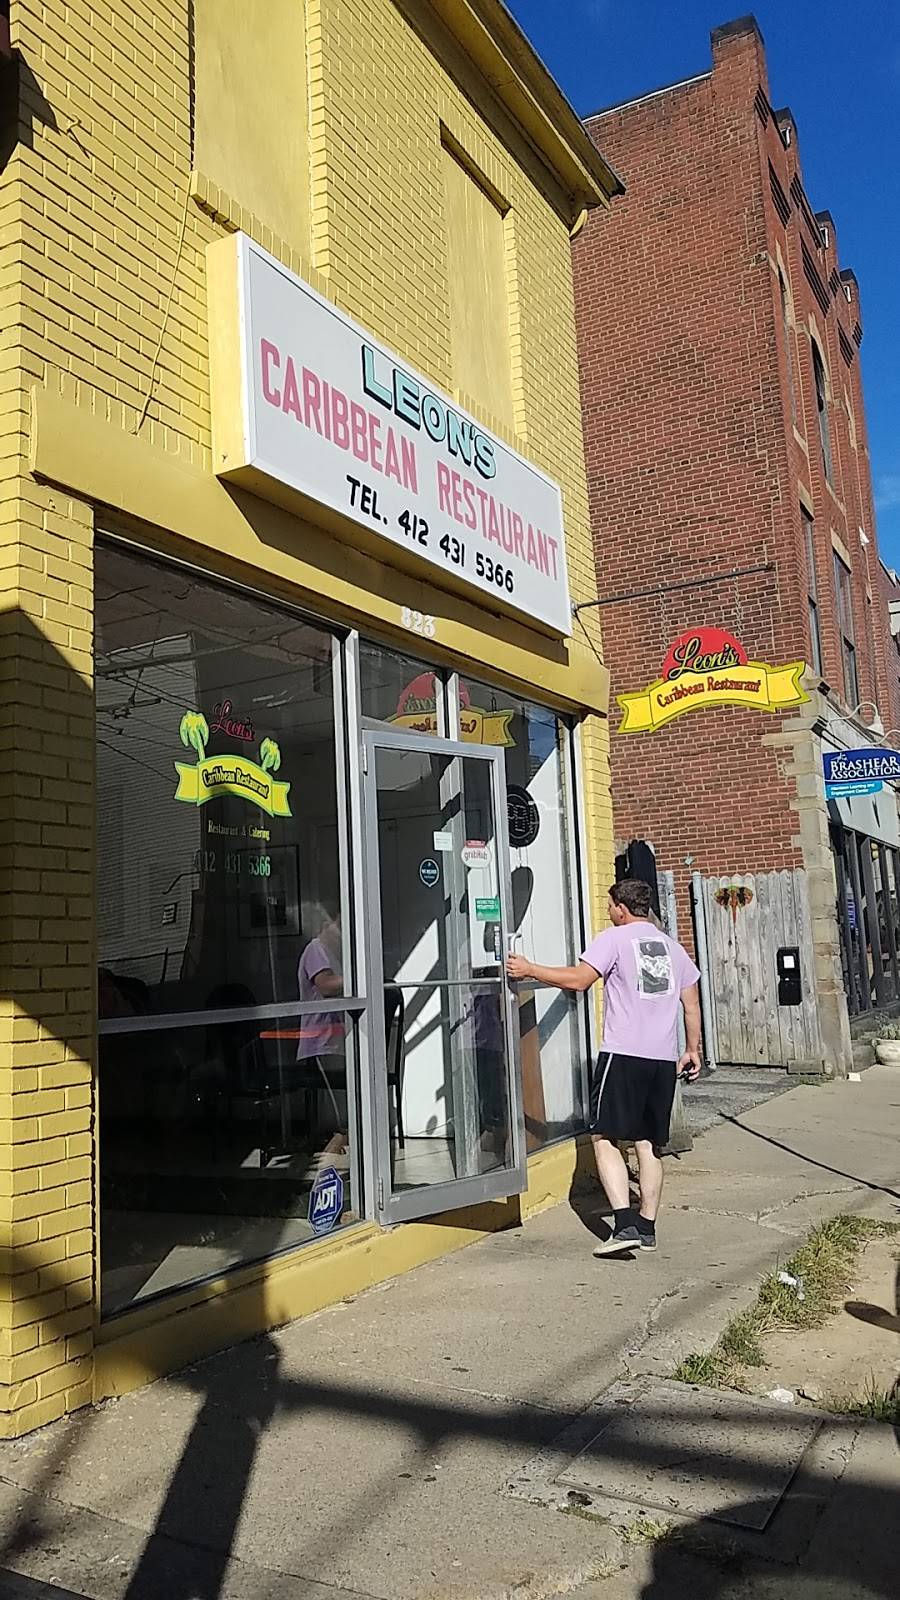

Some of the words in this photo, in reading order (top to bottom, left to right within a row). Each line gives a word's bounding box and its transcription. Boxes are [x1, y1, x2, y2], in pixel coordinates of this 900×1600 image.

[361, 344, 497, 479] LEON'S
[260, 338, 419, 494] CARIBBEAN
[437, 460, 558, 580] RESTAURANT
[346, 474, 388, 525] TEL.
[398, 509, 429, 547] 412
[439, 533, 465, 568] 431
[475, 551, 514, 593] 5366
[668, 637, 740, 680] Leon's
[657, 682, 704, 707] Caribbean
[707, 676, 762, 694] Restaurant
[209, 700, 255, 741] Leon's
[830, 756, 899, 772] BRASHEAR
[830, 766, 900, 780] ASSOCIATION
[202, 766, 236, 787] Caribbean
[236, 767, 270, 799] Restaurant
[249, 825, 270, 841] Catering
[224, 853, 241, 874] 431
[248, 855, 271, 877] 5366
[314, 1186, 336, 1214] ADT
